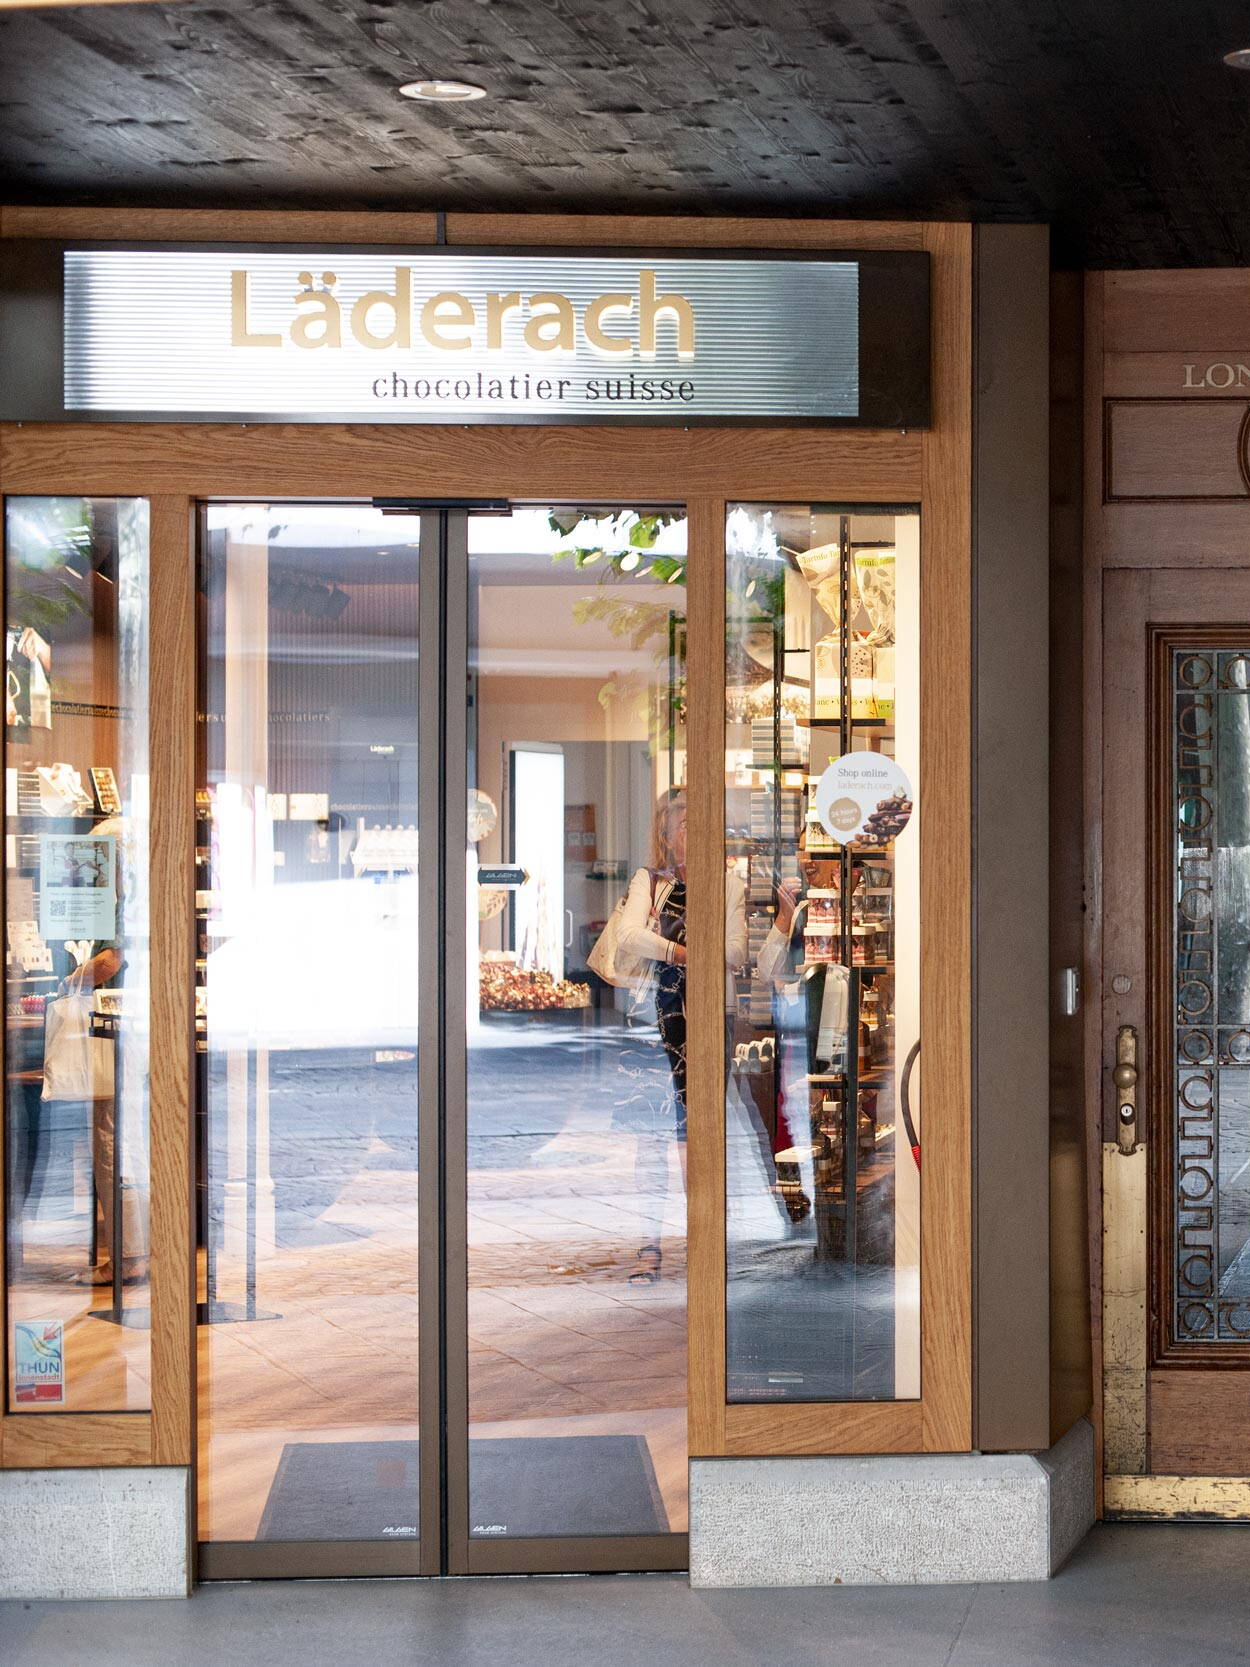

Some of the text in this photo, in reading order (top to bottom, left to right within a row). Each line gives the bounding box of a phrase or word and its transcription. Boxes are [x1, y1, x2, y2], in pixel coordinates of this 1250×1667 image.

[230, 266, 695, 353] Läderach
[371, 371, 696, 402] chocolatier suisse
[837, 768, 889, 779] Shop online
[18, 1361, 60, 1374] THUN
